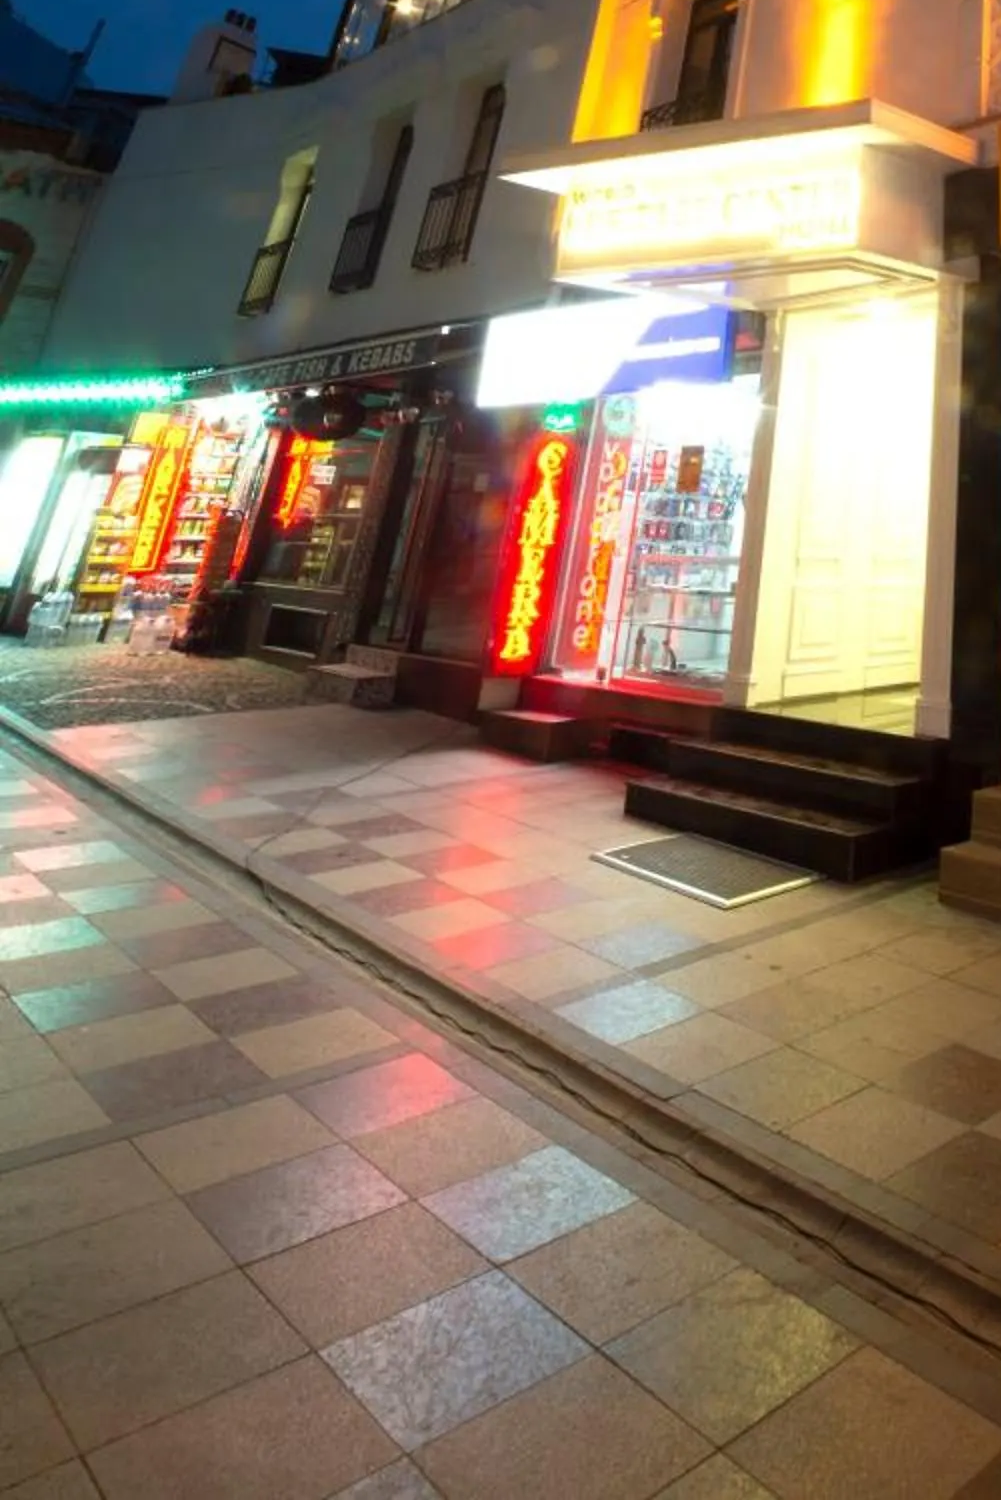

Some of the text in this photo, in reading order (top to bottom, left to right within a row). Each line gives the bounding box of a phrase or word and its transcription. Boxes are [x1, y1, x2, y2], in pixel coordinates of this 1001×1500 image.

[293, 356, 329, 381] FISH
[331, 355, 344, 375] &
[346, 340, 417, 373] KEBABS
[500, 440, 569, 661] CAMERA
